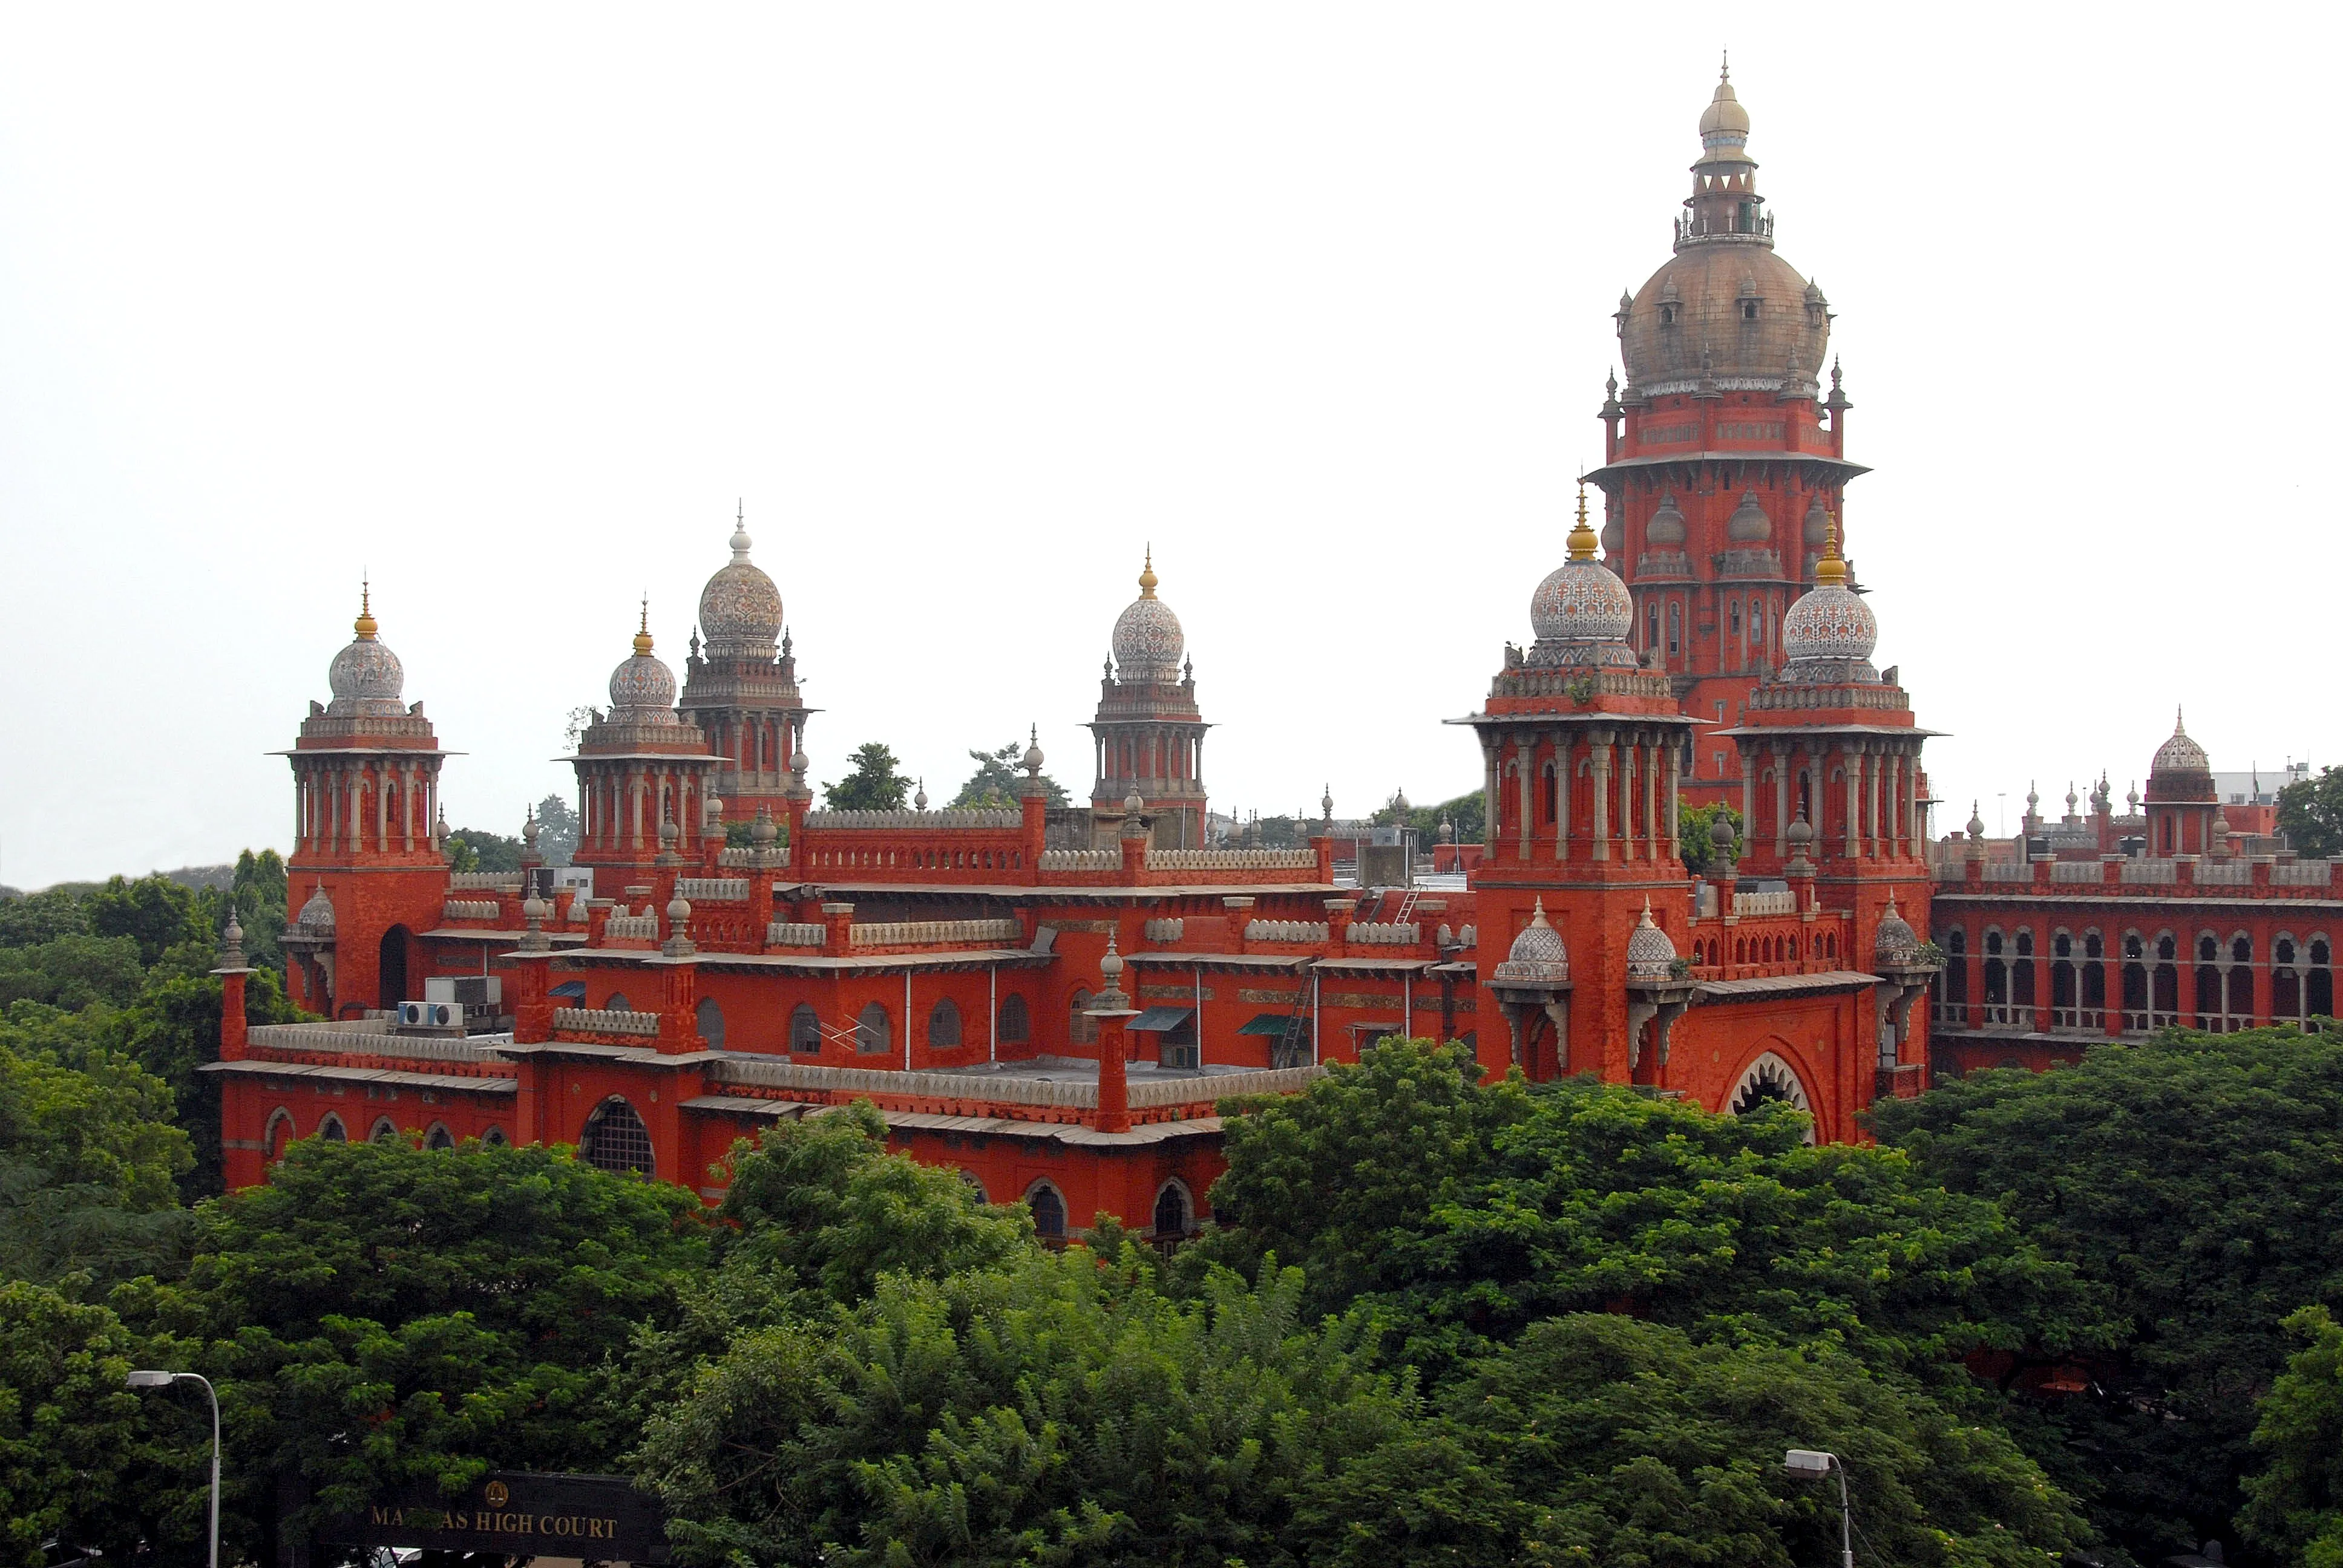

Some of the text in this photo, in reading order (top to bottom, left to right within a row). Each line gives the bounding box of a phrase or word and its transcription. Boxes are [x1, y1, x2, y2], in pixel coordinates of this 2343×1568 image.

[372, 1505, 617, 1538] MAAS HIGH COURT
